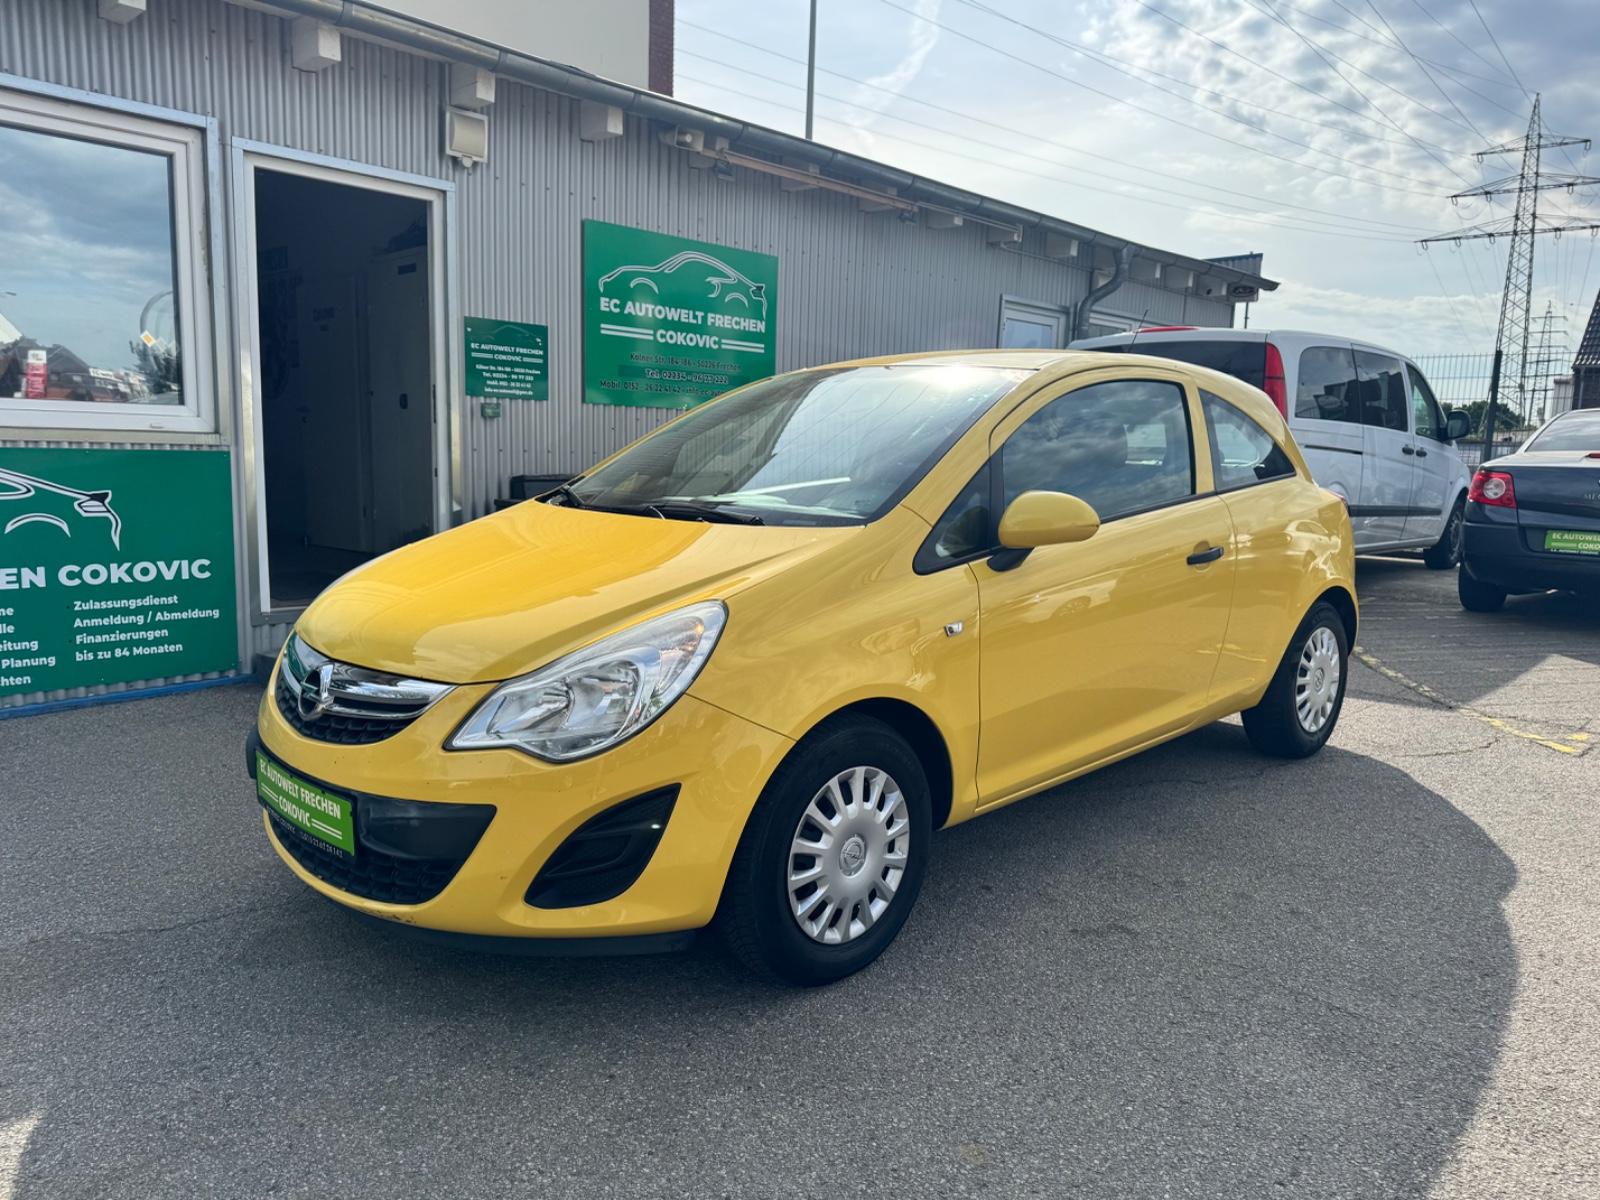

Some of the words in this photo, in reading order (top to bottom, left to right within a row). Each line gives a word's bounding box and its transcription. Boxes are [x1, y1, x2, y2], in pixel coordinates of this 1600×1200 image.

[600, 297, 620, 313] EC
[624, 301, 704, 325] AUTOWELT
[707, 313, 765, 333] FRECHEN
[656, 329, 719, 349] COKOVIC
[480, 344, 515, 353] AUTOWELT
[516, 347, 544, 355] FRECHEN
[494, 354, 522, 362] COKOVIC
[1552, 532, 1561, 540] EC
[58, 559, 212, 587] COKOVIC
[73, 595, 178, 611] Zulassungsdienst
[73, 613, 145, 628] Anmeldung
[147, 611, 152, 623] /
[155, 608, 220, 622] Abmeldung
[75, 628, 169, 644] Finanzierungen
[75, 650, 94, 662] bis
[97, 650, 111, 660] zu
[114, 647, 130, 658] 84
[133, 643, 183, 656] Monaten
[1, 656, 56, 669] Planung
[0, 676, 31, 687] hten
[260, 758, 268, 776] EC
[267, 765, 299, 798] AUTOWELT
[301, 787, 341, 820] FRECHEN
[278, 795, 311, 828] COKOVIC
